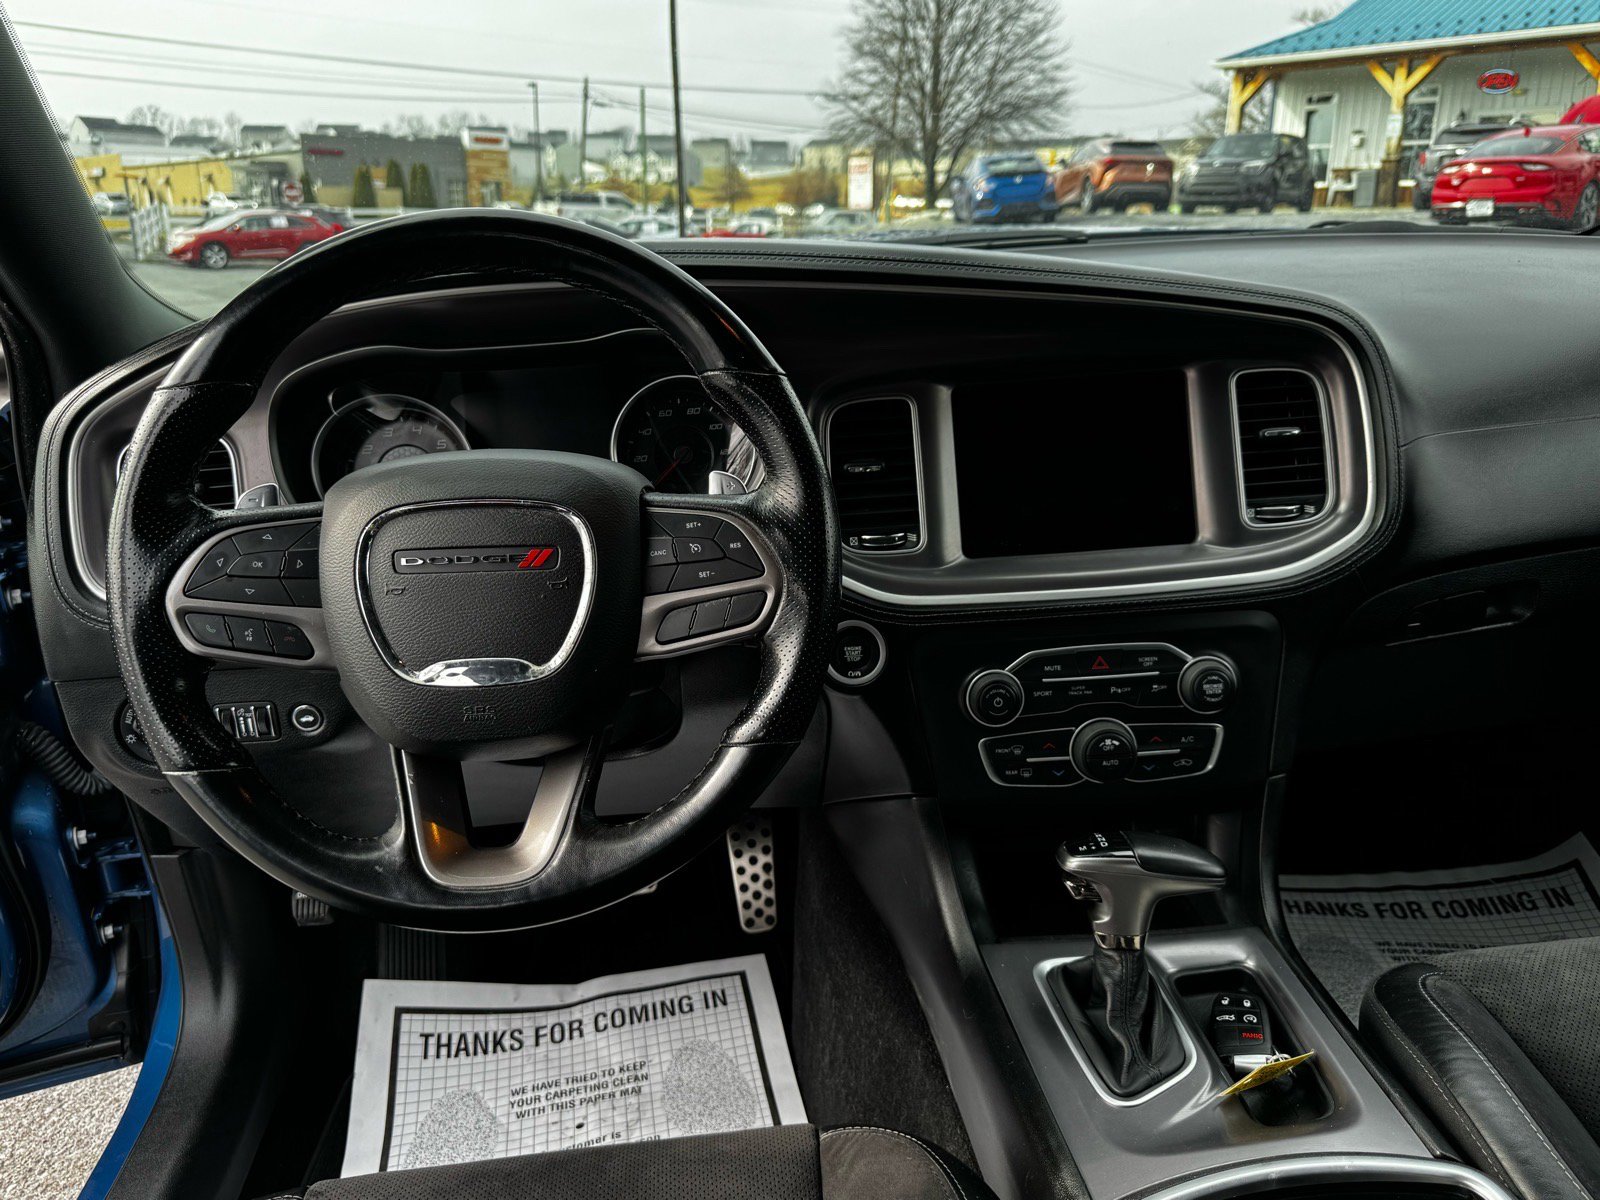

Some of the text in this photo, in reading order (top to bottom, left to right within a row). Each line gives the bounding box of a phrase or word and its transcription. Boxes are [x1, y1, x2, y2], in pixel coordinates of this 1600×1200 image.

[658, 409, 673, 417] 60
[686, 407, 701, 415] 80
[383, 428, 394, 437] 3
[412, 425, 423, 435] 4
[436, 440, 447, 449] 5
[400, 553, 529, 566] DODGE
[1044, 664, 1063, 672] MUTE
[1282, 886, 1576, 920] HANKS FOR COMING IN
[419, 988, 729, 1060] THANKS FOR COMING IN
[1241, 1032, 1264, 1040] PANIC
[511, 1060, 646, 1097] WE HAVE TRIED TO KEEP
[510, 1072, 649, 1109] YOUR CARPETING CLEAN
[516, 1085, 642, 1119] WITH THIS PAPER MAT
[611, 1131, 622, 1139] is
